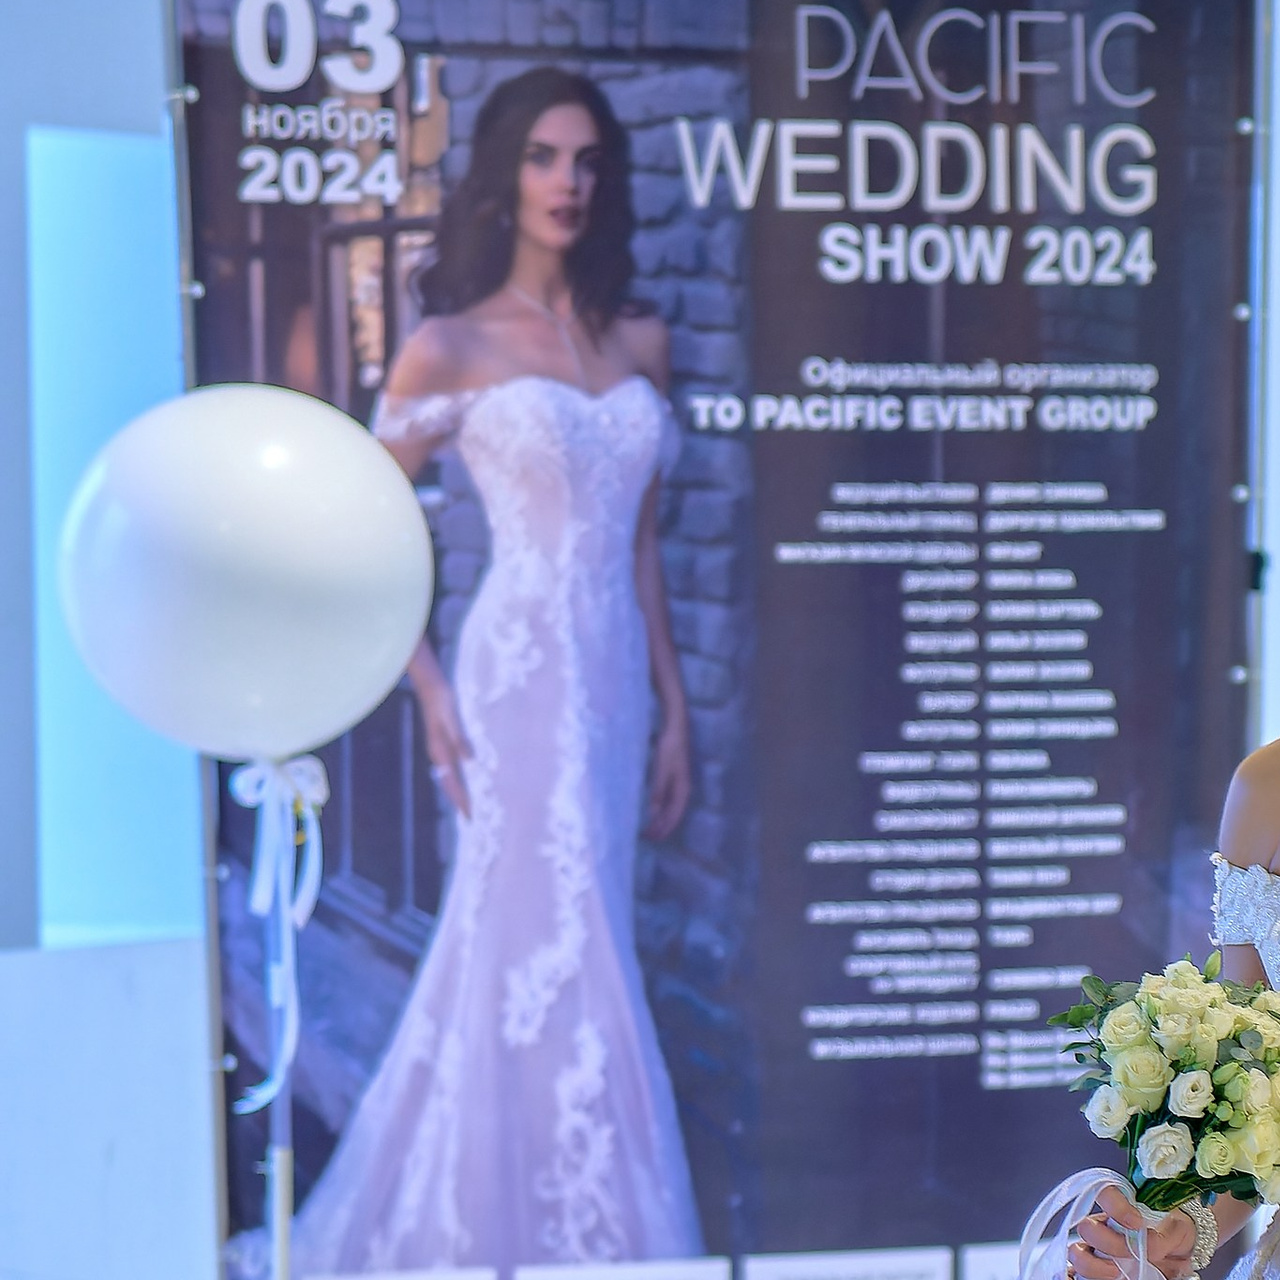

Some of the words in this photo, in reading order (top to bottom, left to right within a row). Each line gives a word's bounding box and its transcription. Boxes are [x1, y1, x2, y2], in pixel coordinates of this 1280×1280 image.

[233, 0, 404, 93] 03
[796, 4, 1157, 108] PACIFIC
[241, 97, 396, 148] ноября
[238, 145, 404, 206] 2024
[676, 116, 1159, 215] WEDDING
[819, 222, 1011, 284] SHOW
[1024, 226, 1158, 286] 2024
[690, 394, 745, 430] TO
[751, 394, 903, 431] PACIFIC
[909, 394, 1033, 431] EVENT
[1037, 394, 1158, 431] GROUP
